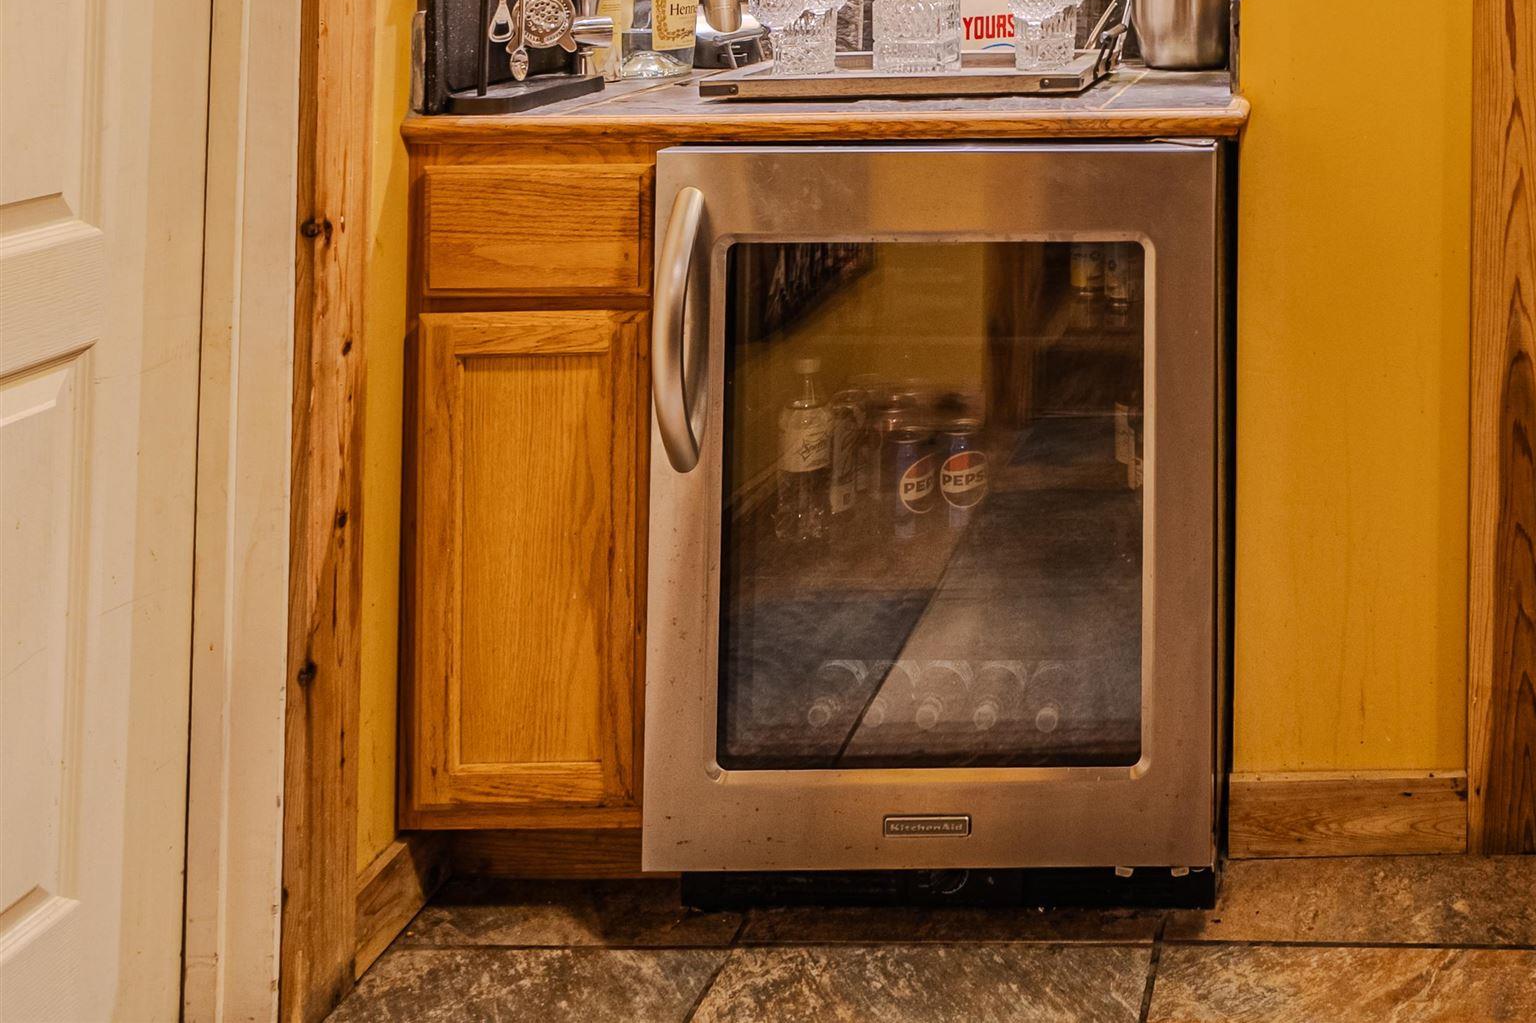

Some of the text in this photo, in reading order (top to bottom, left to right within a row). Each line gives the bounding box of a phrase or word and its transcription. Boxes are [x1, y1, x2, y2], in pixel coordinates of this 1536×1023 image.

[669, 3, 697, 17] Henn
[962, 13, 1016, 41] YOURS
[903, 476, 934, 494] PEP
[942, 470, 985, 487] PEPS
[890, 823, 963, 832] KitchenAid
